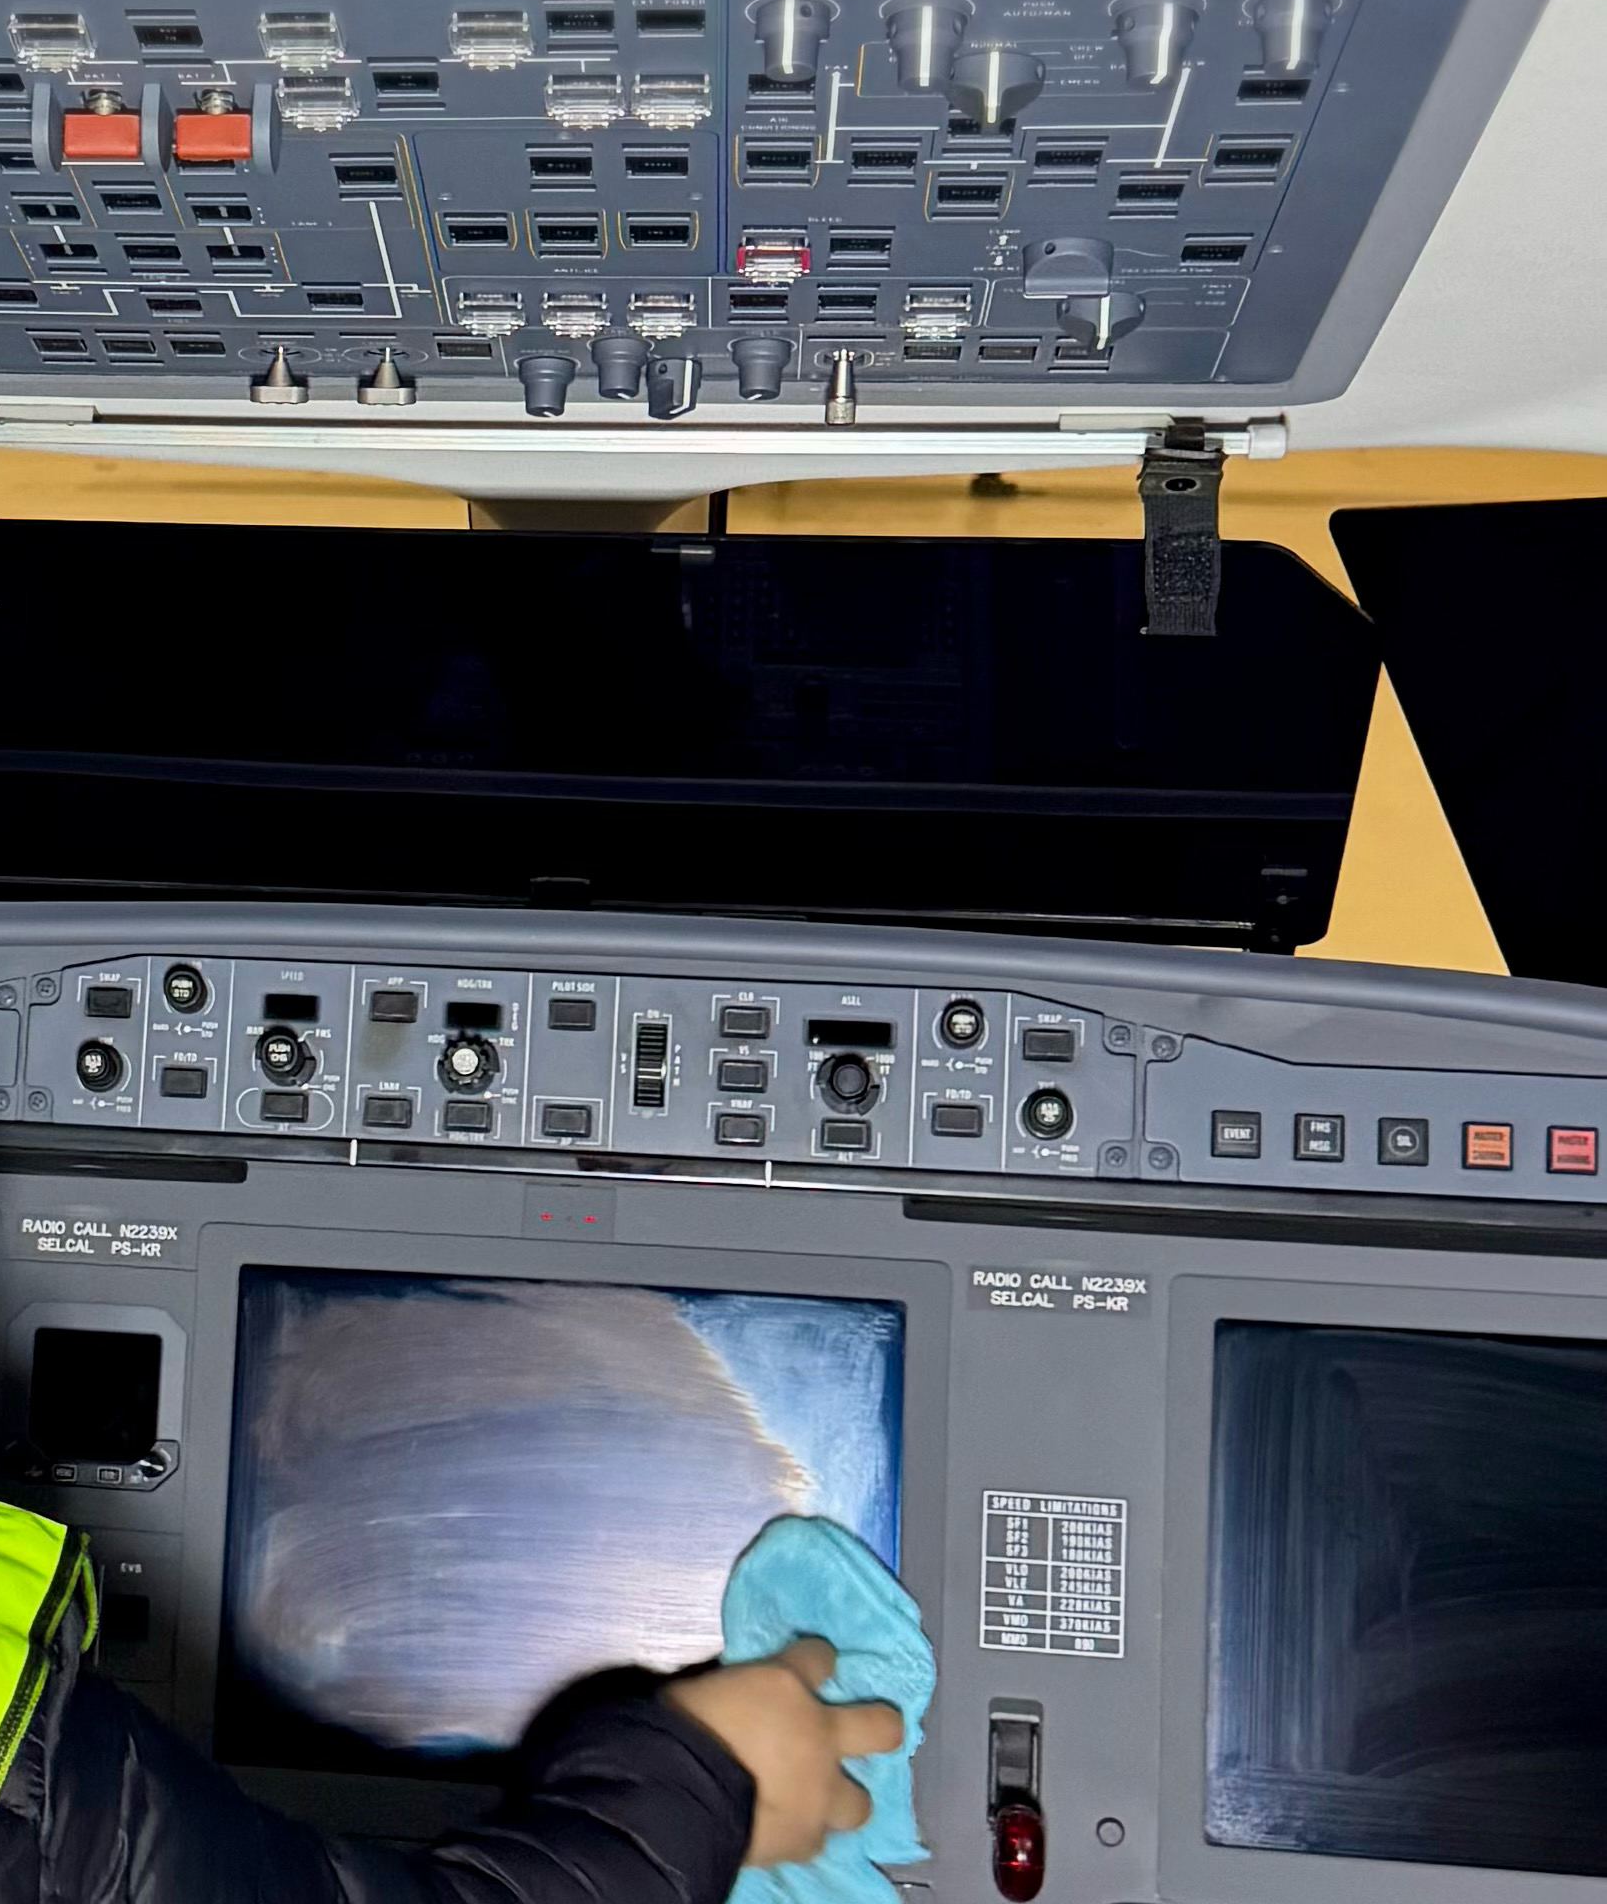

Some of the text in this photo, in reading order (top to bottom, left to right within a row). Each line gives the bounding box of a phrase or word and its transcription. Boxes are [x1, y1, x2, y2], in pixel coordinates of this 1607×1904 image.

[551, 981, 595, 993] PILOT SIDE
[1223, 1127, 1251, 1141] EVENT
[1309, 1120, 1332, 1135] FMS
[1309, 1139, 1332, 1153] MSG
[21, 1218, 179, 1241] RADIO CALL N2239X
[37, 1237, 162, 1258] SELCAL PS-KR
[972, 1270, 1147, 1295] RADIO CALL N2239X
[989, 1289, 1130, 1312] SELCAL PS-KR
[991, 1496, 1118, 1517] SPEED LIMITATIONS
